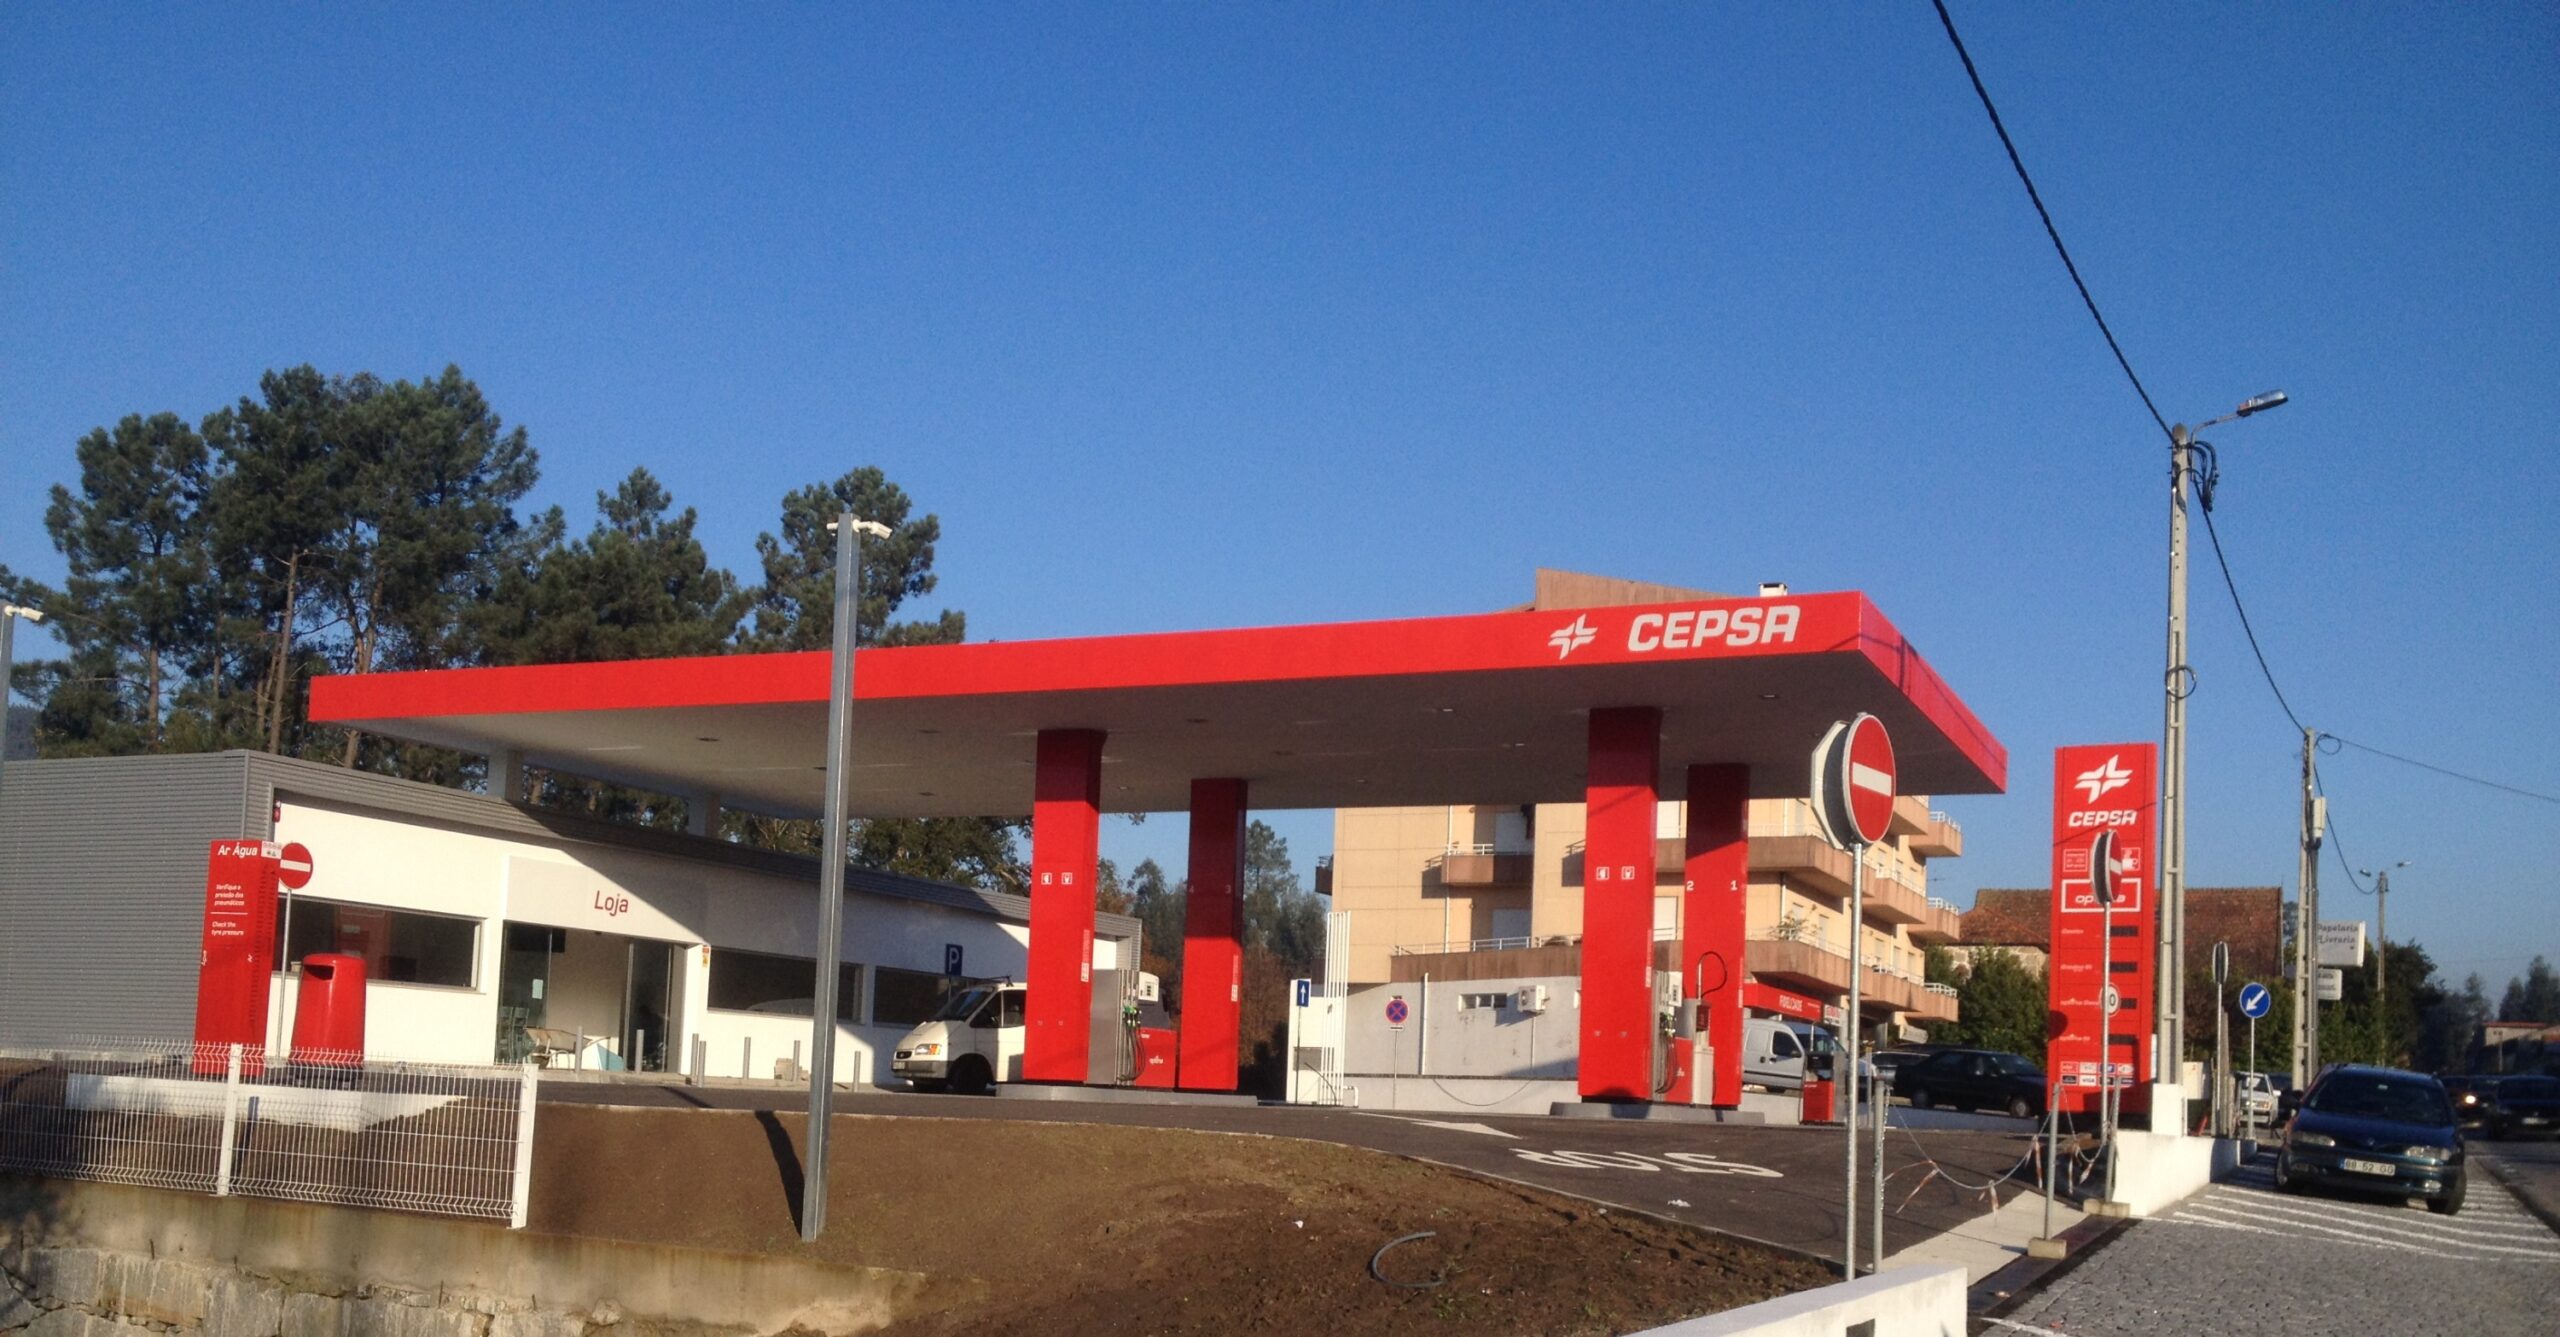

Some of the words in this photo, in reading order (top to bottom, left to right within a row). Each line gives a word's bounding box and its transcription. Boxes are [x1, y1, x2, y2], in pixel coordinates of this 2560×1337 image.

[1627, 605, 1800, 652] CEPSA
[2068, 809, 2138, 828] CEPSA
[218, 845, 231, 856] Ar
[232, 842, 258, 859] Água
[1225, 885, 1232, 894] 3
[1686, 880, 1694, 891] 2
[1730, 880, 1738, 891] 1
[594, 890, 629, 917] Loja
[948, 947, 960, 972] P
